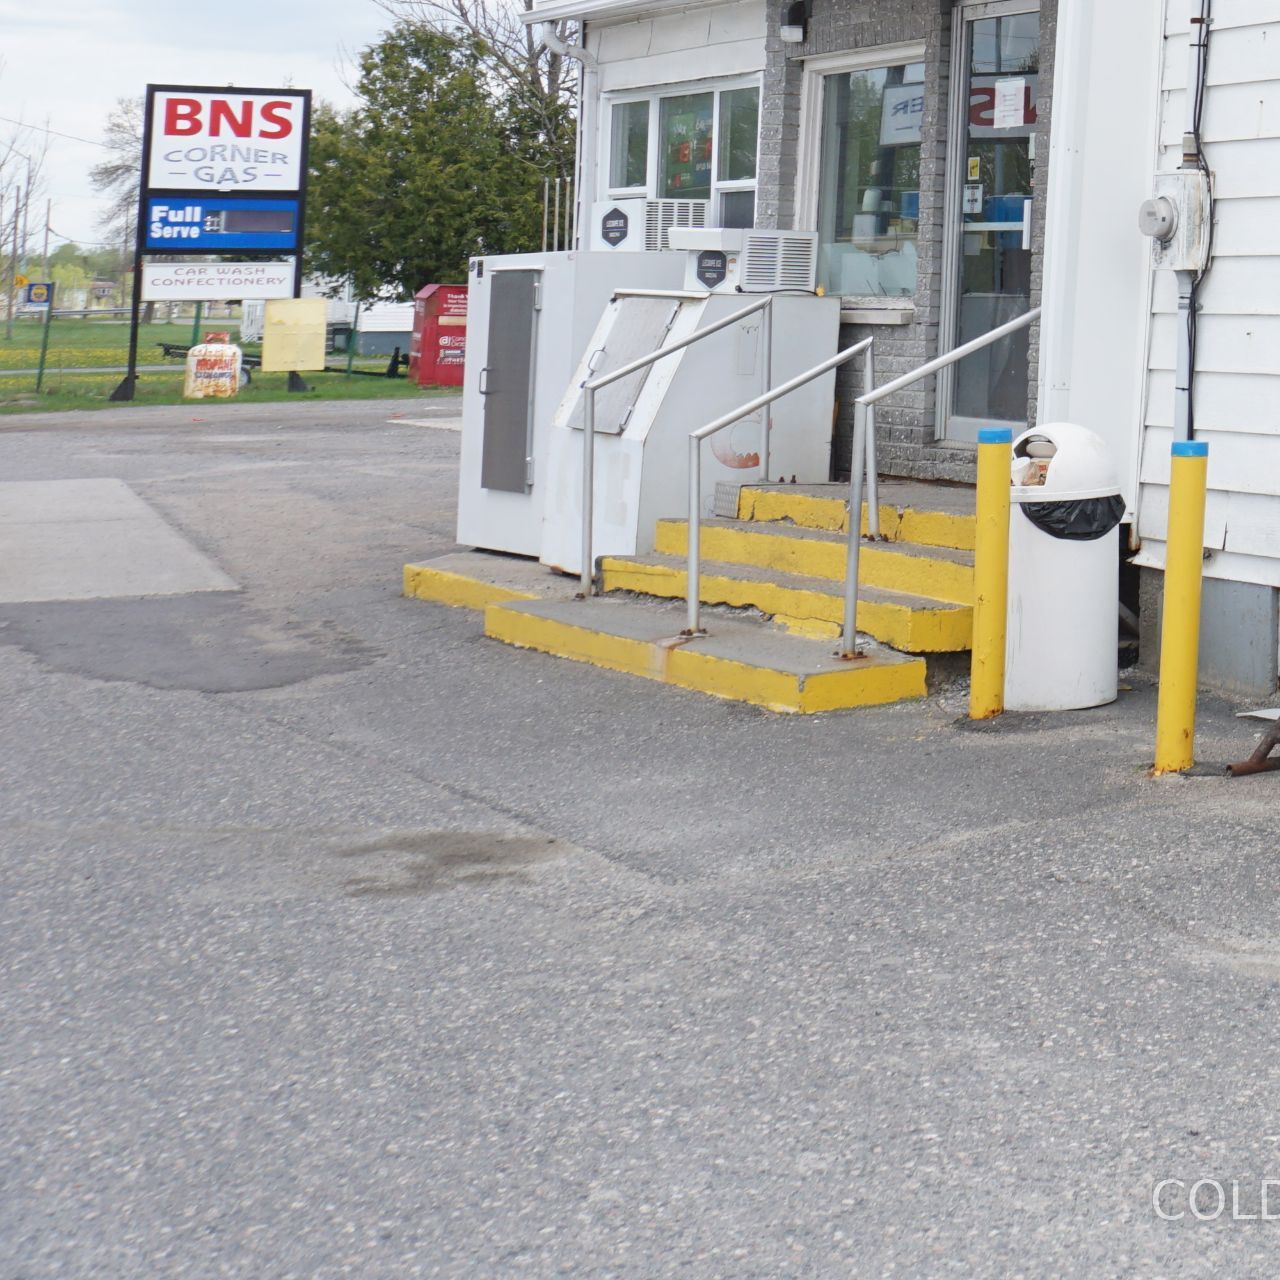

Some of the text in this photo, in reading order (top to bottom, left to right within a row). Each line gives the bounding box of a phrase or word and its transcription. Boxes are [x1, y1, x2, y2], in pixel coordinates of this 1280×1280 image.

[163, 98, 293, 139] BNS
[163, 144, 289, 165] CORNER
[193, 165, 259, 185] GAS
[151, 205, 202, 222] Full
[150, 222, 200, 238] Serve
[174, 267, 265, 276] CAR WASH
[151, 277, 287, 286] CONFECTIONERY
